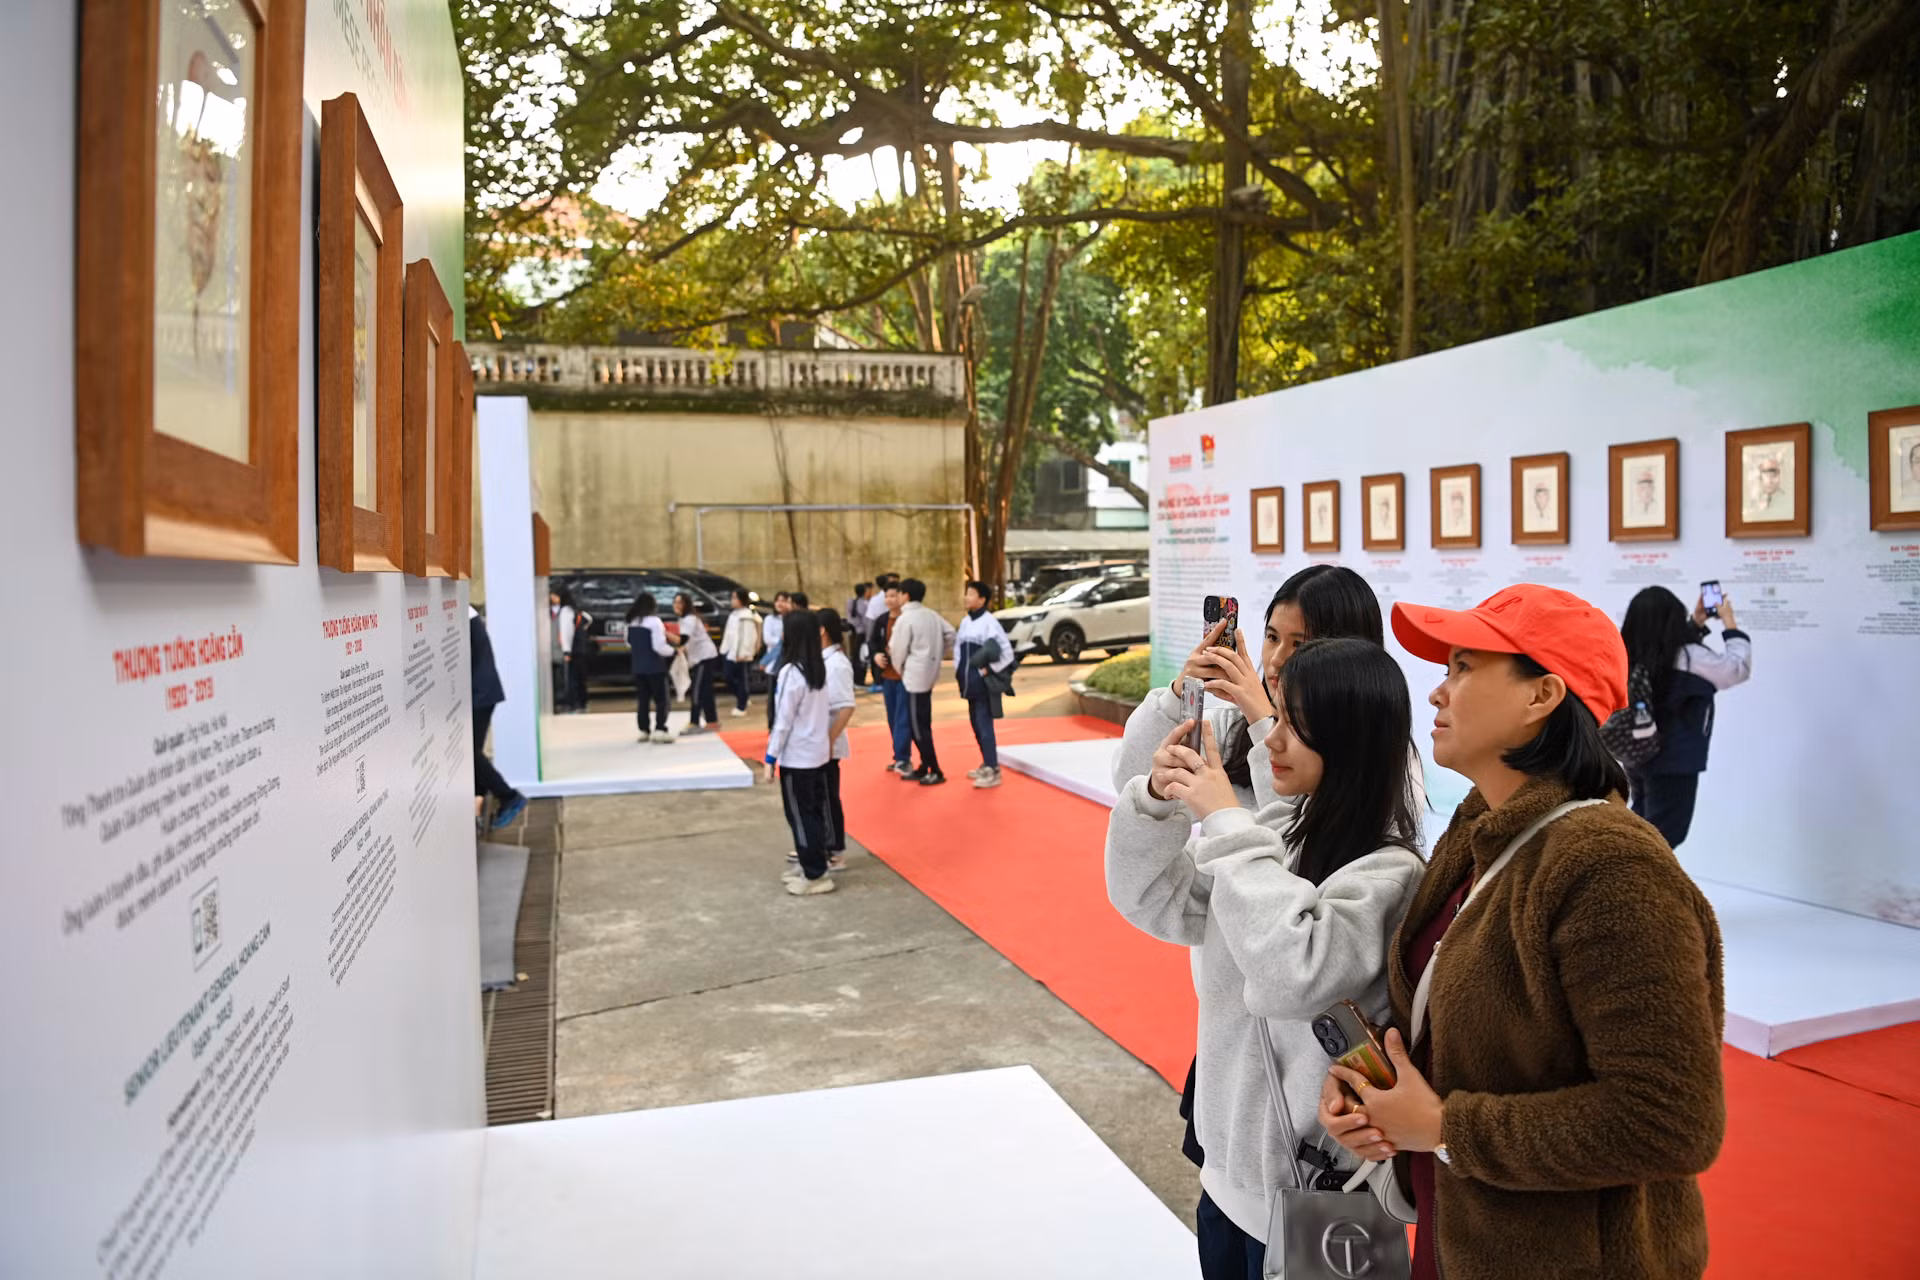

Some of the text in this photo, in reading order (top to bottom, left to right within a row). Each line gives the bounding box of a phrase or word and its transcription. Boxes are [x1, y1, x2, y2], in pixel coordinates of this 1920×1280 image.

[112, 623, 244, 684] THƯỢNG TƯỚNG HOÀNG CẦM
